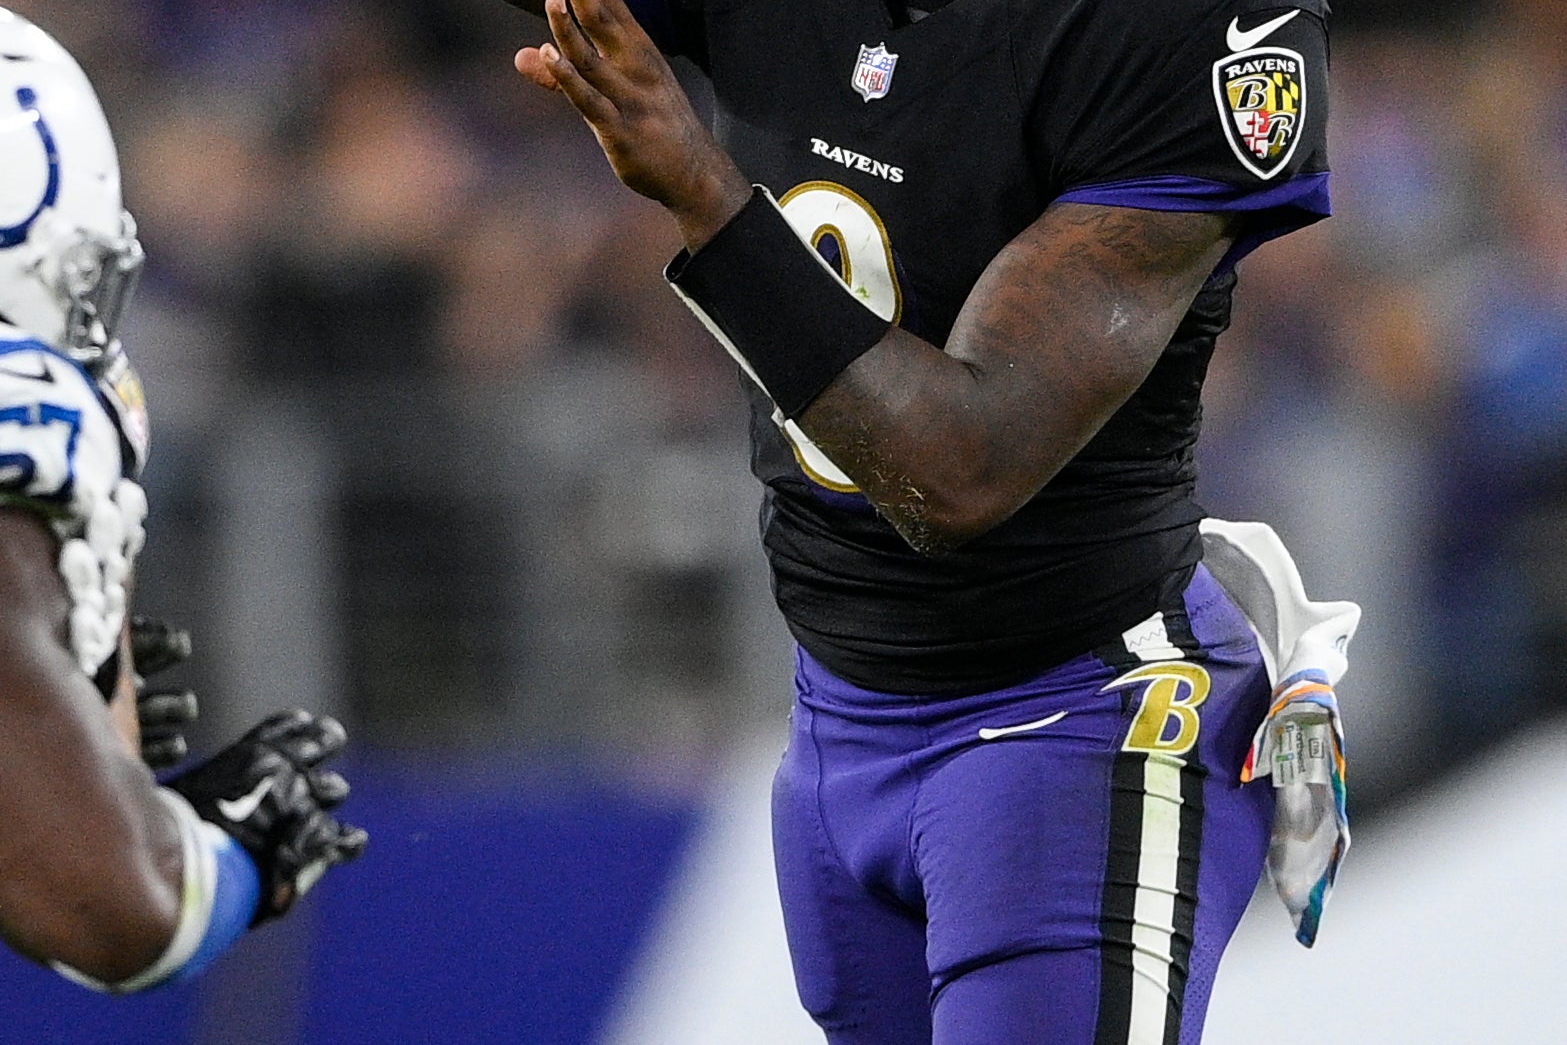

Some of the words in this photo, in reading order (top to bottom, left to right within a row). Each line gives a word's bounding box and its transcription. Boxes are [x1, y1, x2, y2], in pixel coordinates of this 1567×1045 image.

[1225, 59, 1297, 79] RAVENS
[810, 137, 905, 184] RAVENS
[1096, 660, 1211, 755] B
